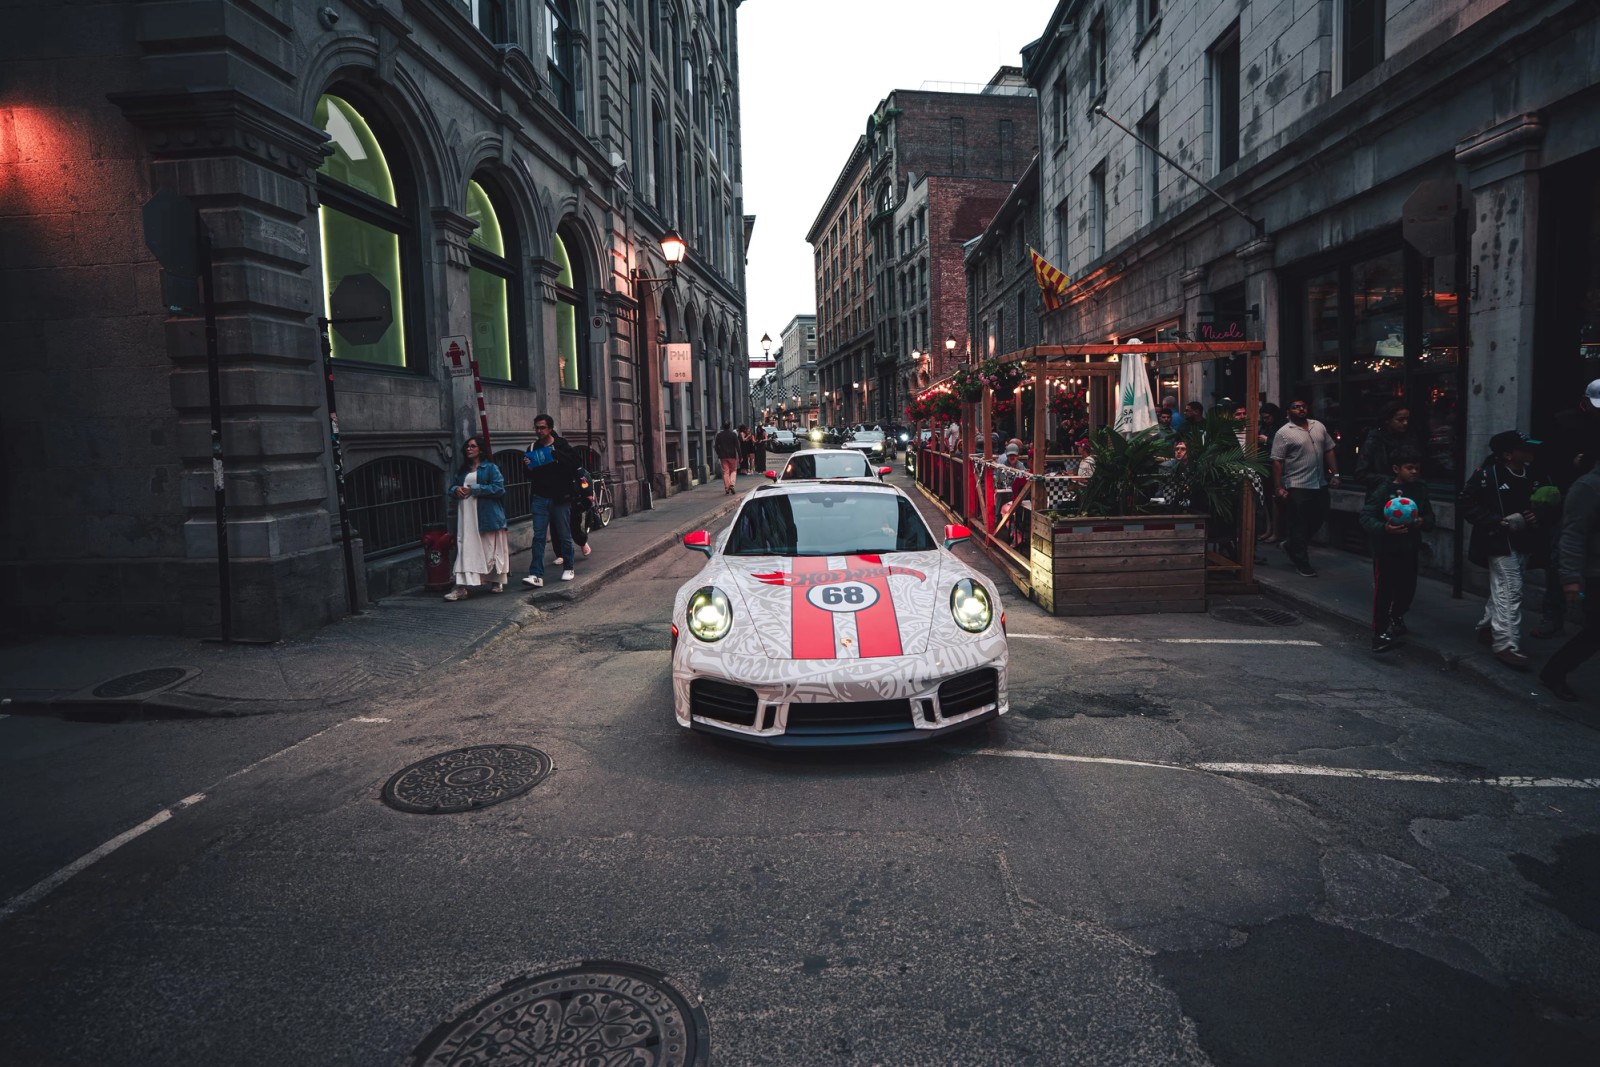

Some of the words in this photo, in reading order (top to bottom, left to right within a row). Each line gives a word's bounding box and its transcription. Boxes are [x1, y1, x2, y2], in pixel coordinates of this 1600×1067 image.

[1202, 322, 1244, 339] Nicole
[670, 351, 689, 360] PHI
[822, 587, 865, 605] 68
[598, 976, 674, 1016] EGOUT
